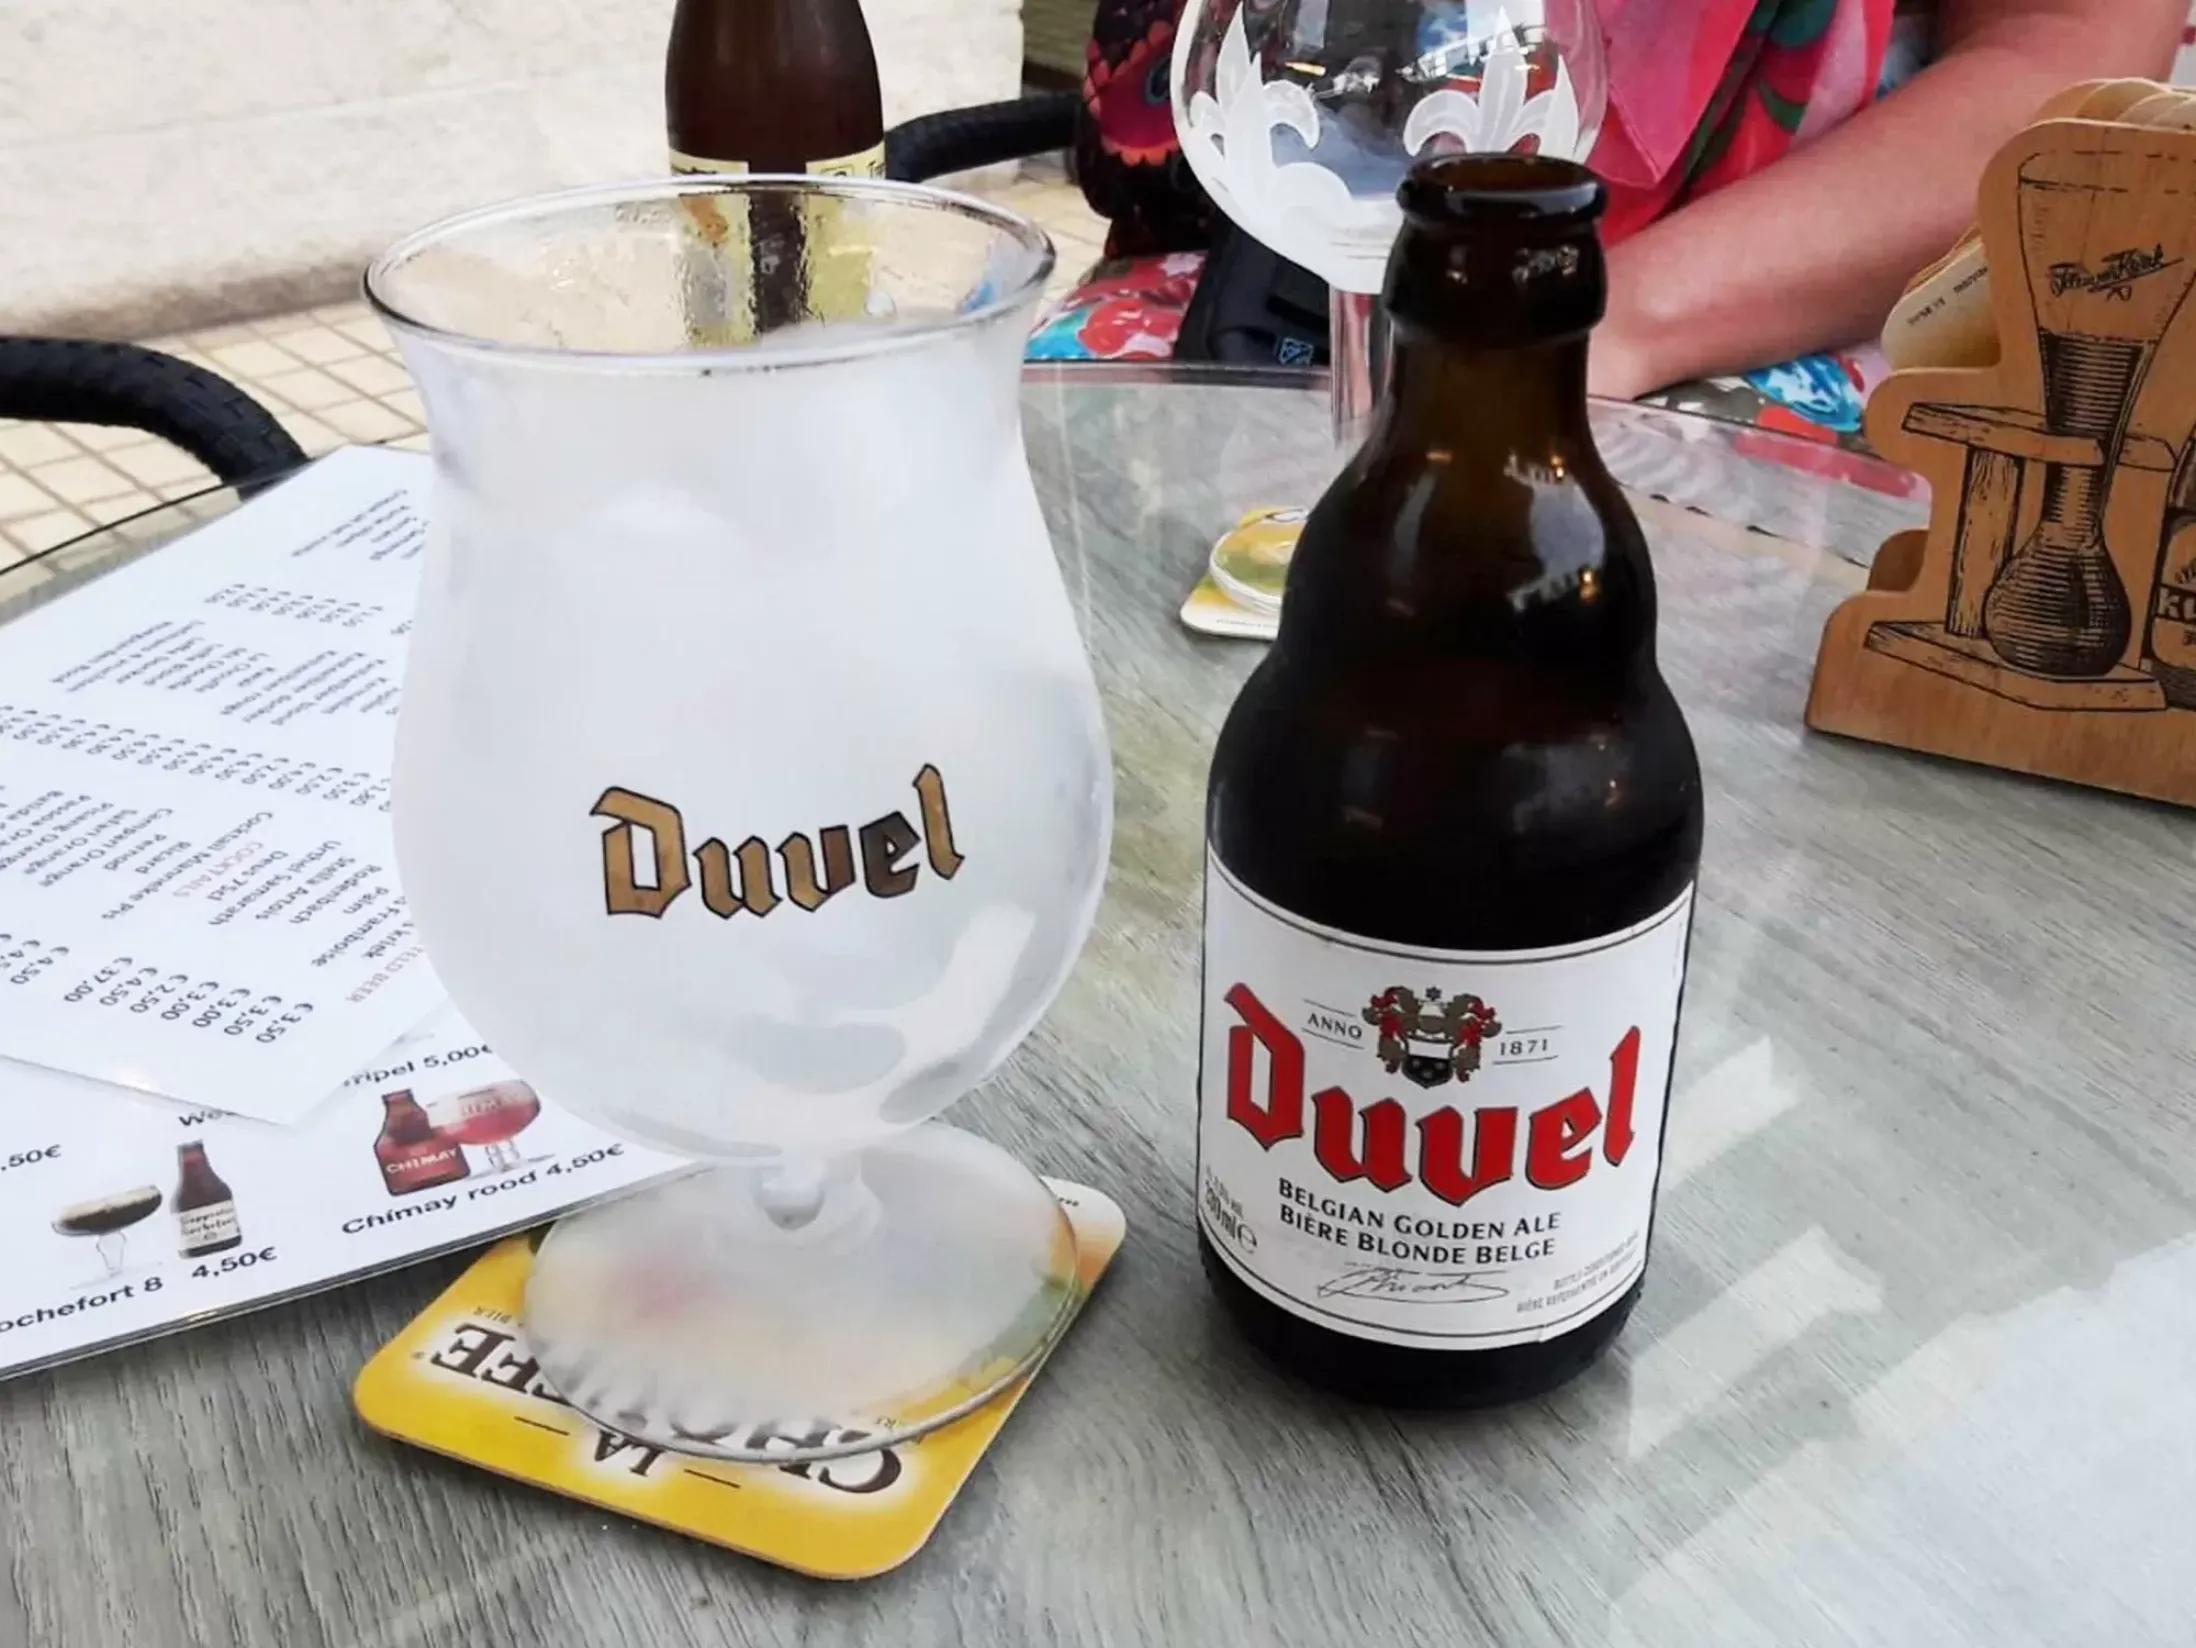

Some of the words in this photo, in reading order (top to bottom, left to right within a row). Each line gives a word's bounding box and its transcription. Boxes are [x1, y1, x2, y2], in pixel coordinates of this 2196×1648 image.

[589, 763, 965, 919] Duvel
[290, 865, 382, 924] Rodenbach
[343, 887, 389, 914] Palm
[10, 956, 53, 984] 4,50
[99, 977, 142, 1006] 4,50
[129, 984, 175, 1013] 2,50
[161, 991, 206, 1020] 3,00
[192, 998, 237, 1027] 3,00
[224, 1005, 269, 1035] 3,50
[256, 1013, 301, 1043] 3,50
[1307, 1013, 1363, 1041] ANNO
[1500, 1039, 1550, 1057] 1871
[344, 1061, 414, 1088] ripel
[1224, 982, 1641, 1206] Duvel
[0, 1144, 62, 1172] ,50€
[386, 1149, 458, 1174] CHIMAY
[342, 1194, 457, 1234] Chimay
[467, 1170, 538, 1200] rood
[1278, 1177, 1385, 1230] BELGIAN
[1394, 1215, 1504, 1241] GOLDEN
[1513, 1212, 1562, 1237] ALE
[1280, 1204, 1349, 1246] BIÈRE
[1357, 1233, 1467, 1265] BLONDE
[1475, 1238, 1556, 1264] BELGE
[0, 1286, 134, 1334] ochefort
[144, 1276, 163, 1292] 8
[594, 1430, 668, 1477] LA
